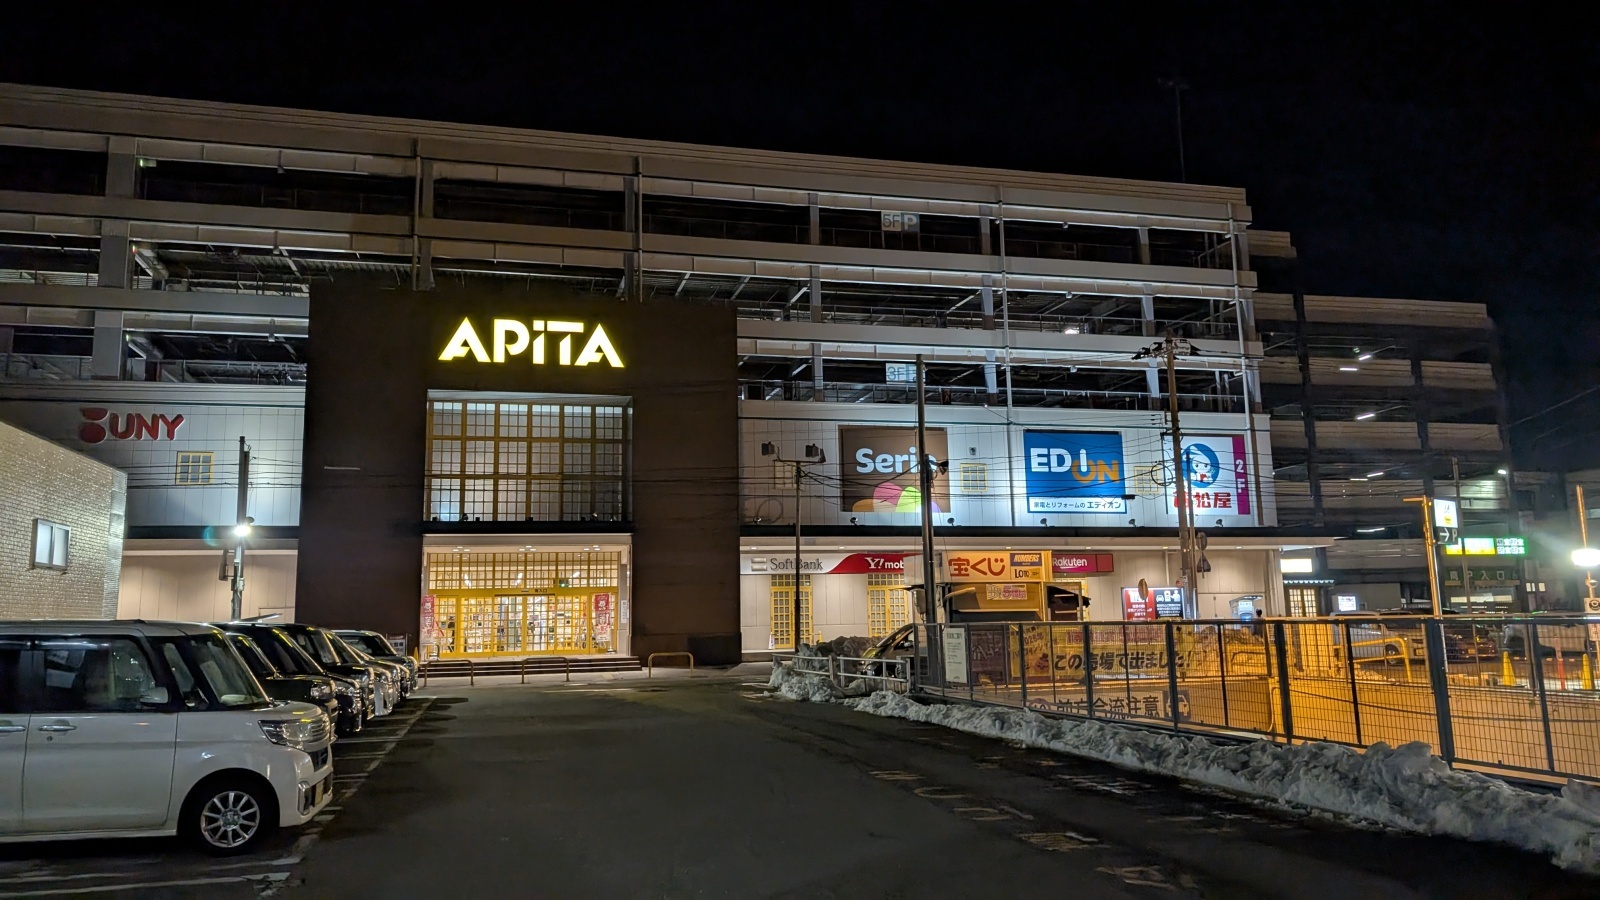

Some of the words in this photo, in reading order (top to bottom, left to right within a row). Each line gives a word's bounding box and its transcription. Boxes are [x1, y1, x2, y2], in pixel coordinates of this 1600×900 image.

[109, 412, 184, 441] UNY
[855, 446, 938, 473] Seri
[1030, 447, 1120, 484] EDION
[1033, 501, 1085, 509] 家電とリフォームの
[770, 557, 823, 571] SoftBank
[1014, 554, 1040, 562] NUMBERS
[1053, 557, 1087, 567] Rakuten
[948, 557, 1006, 577] 宝くじ
